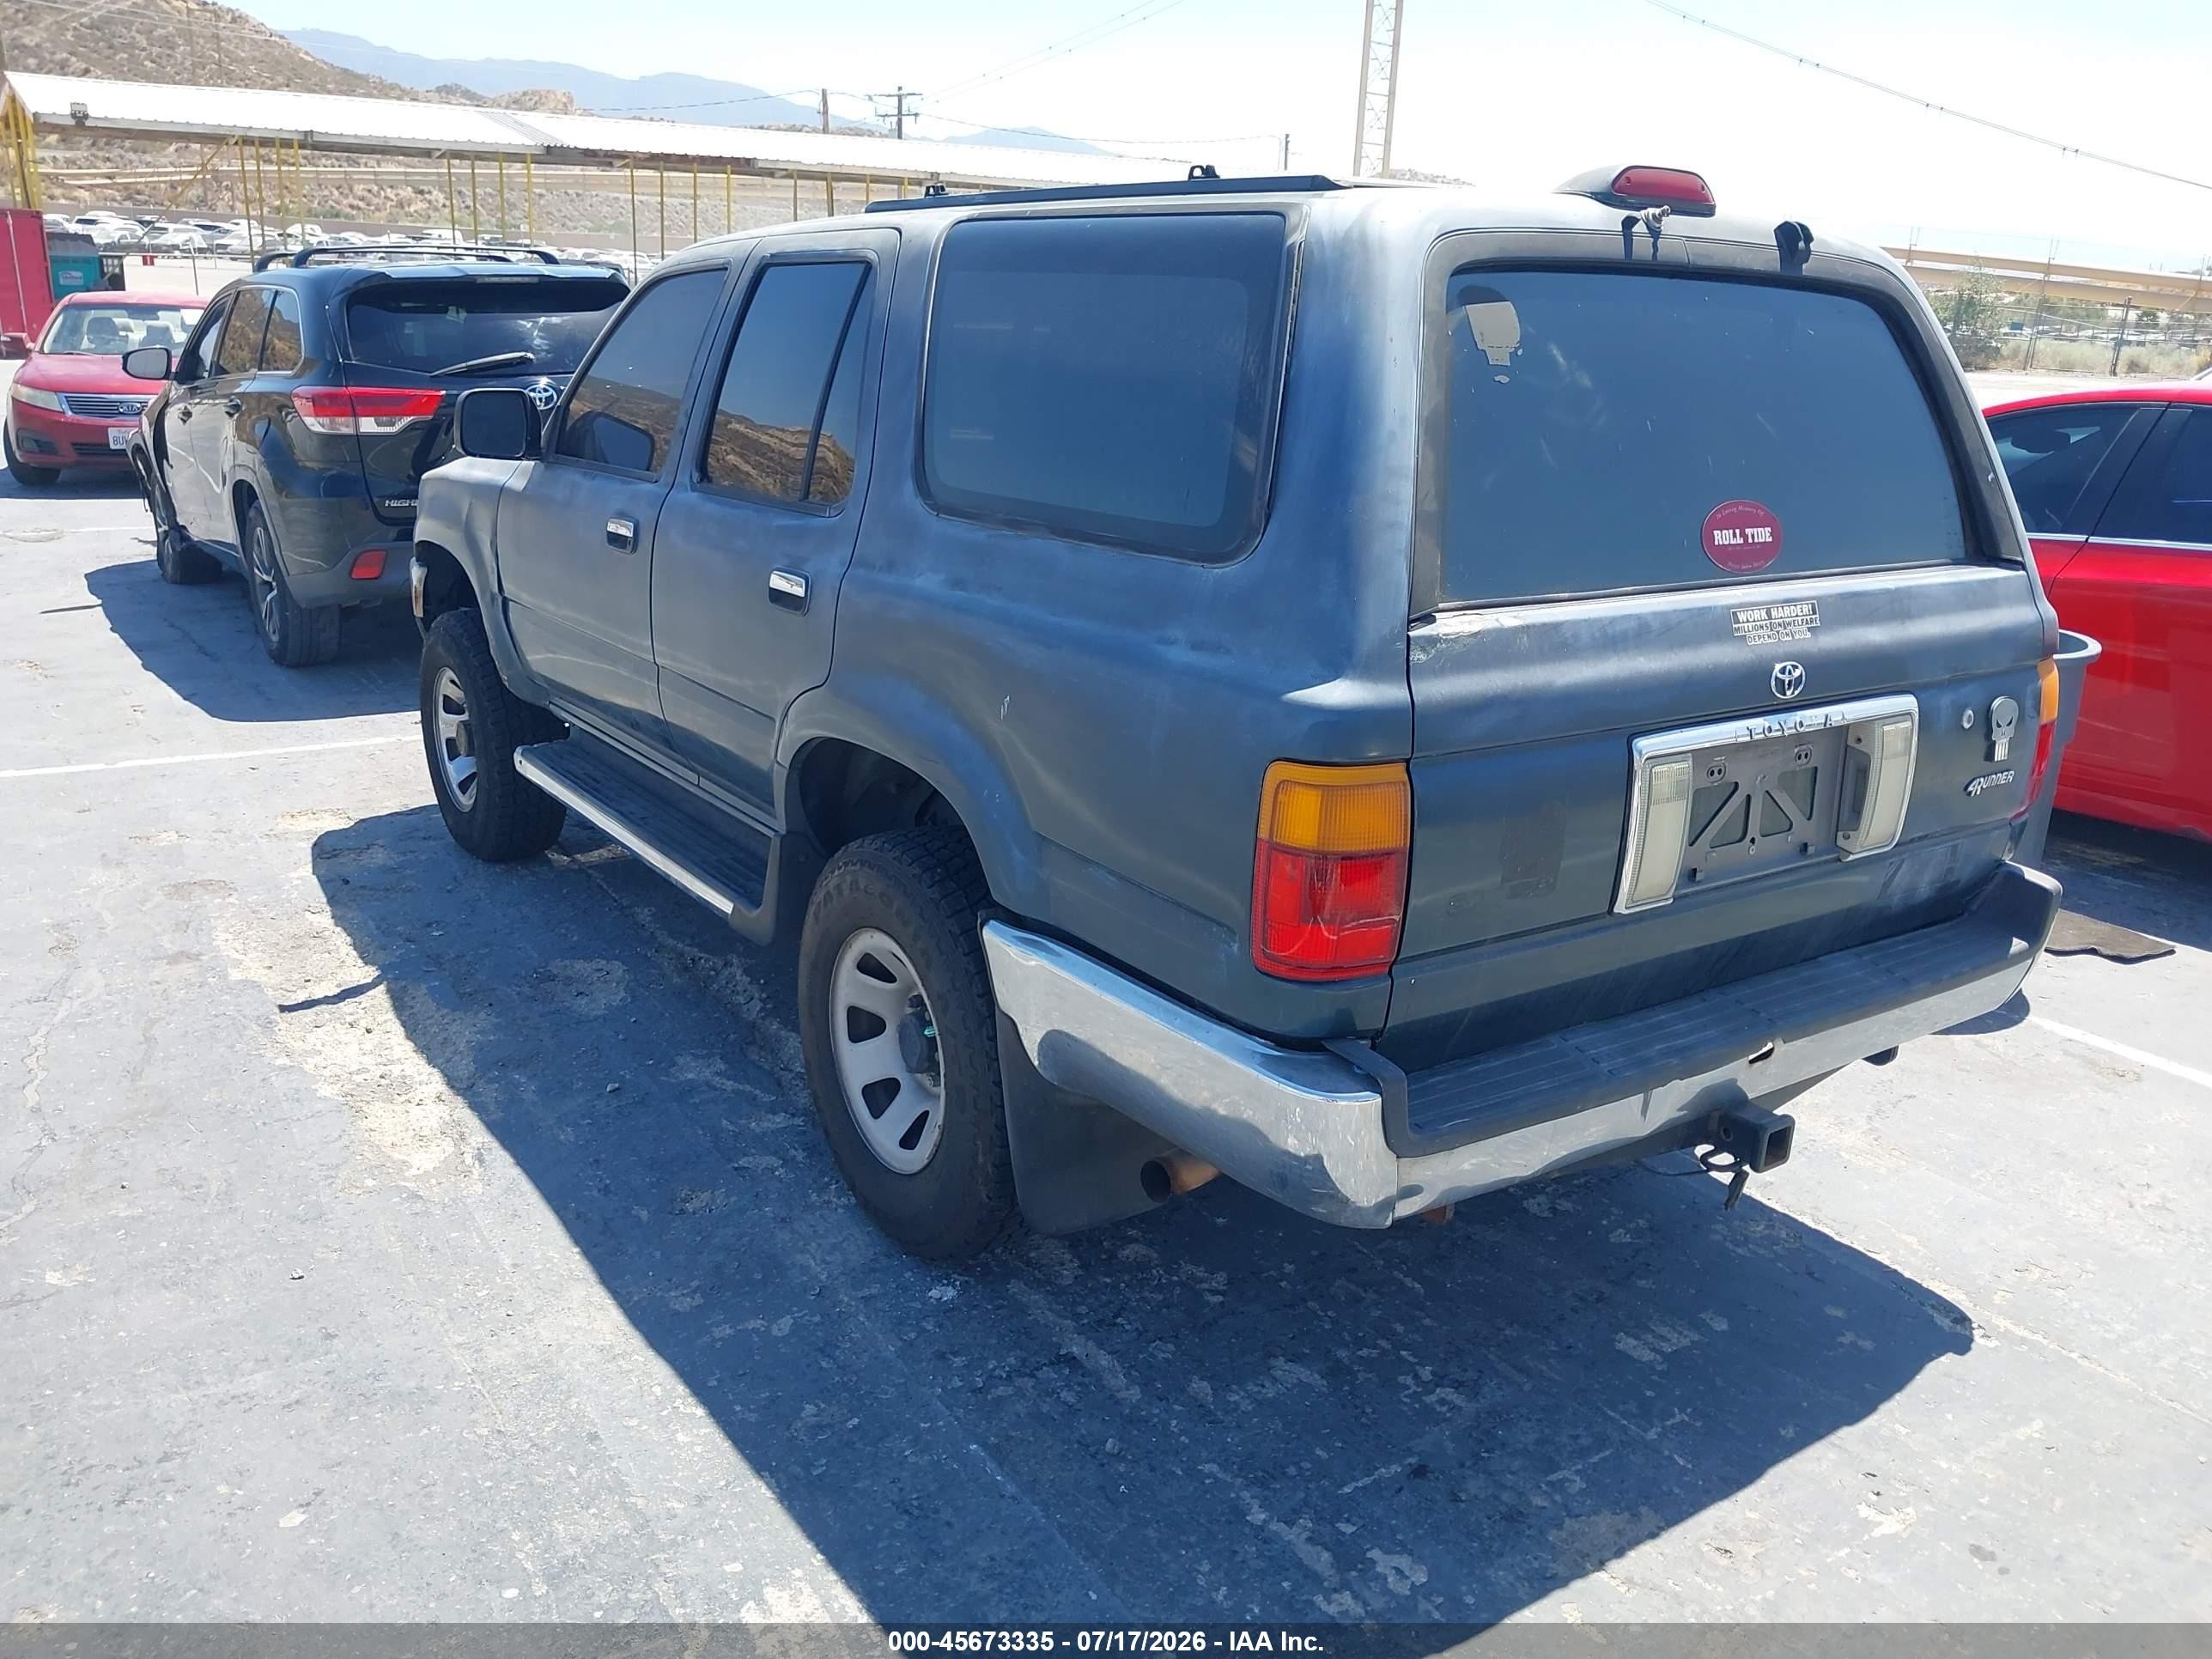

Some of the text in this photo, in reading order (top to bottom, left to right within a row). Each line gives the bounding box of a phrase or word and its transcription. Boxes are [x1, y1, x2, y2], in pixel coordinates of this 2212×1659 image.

[1713, 527, 1772, 545] ROLL TIDE
[1736, 604, 1813, 623] WORK HARDER!
[1734, 617, 1820, 635] MILLIONS ON WELFARE
[1747, 634, 1777, 644] DEPEND
[1792, 629, 1810, 638] YOU.
